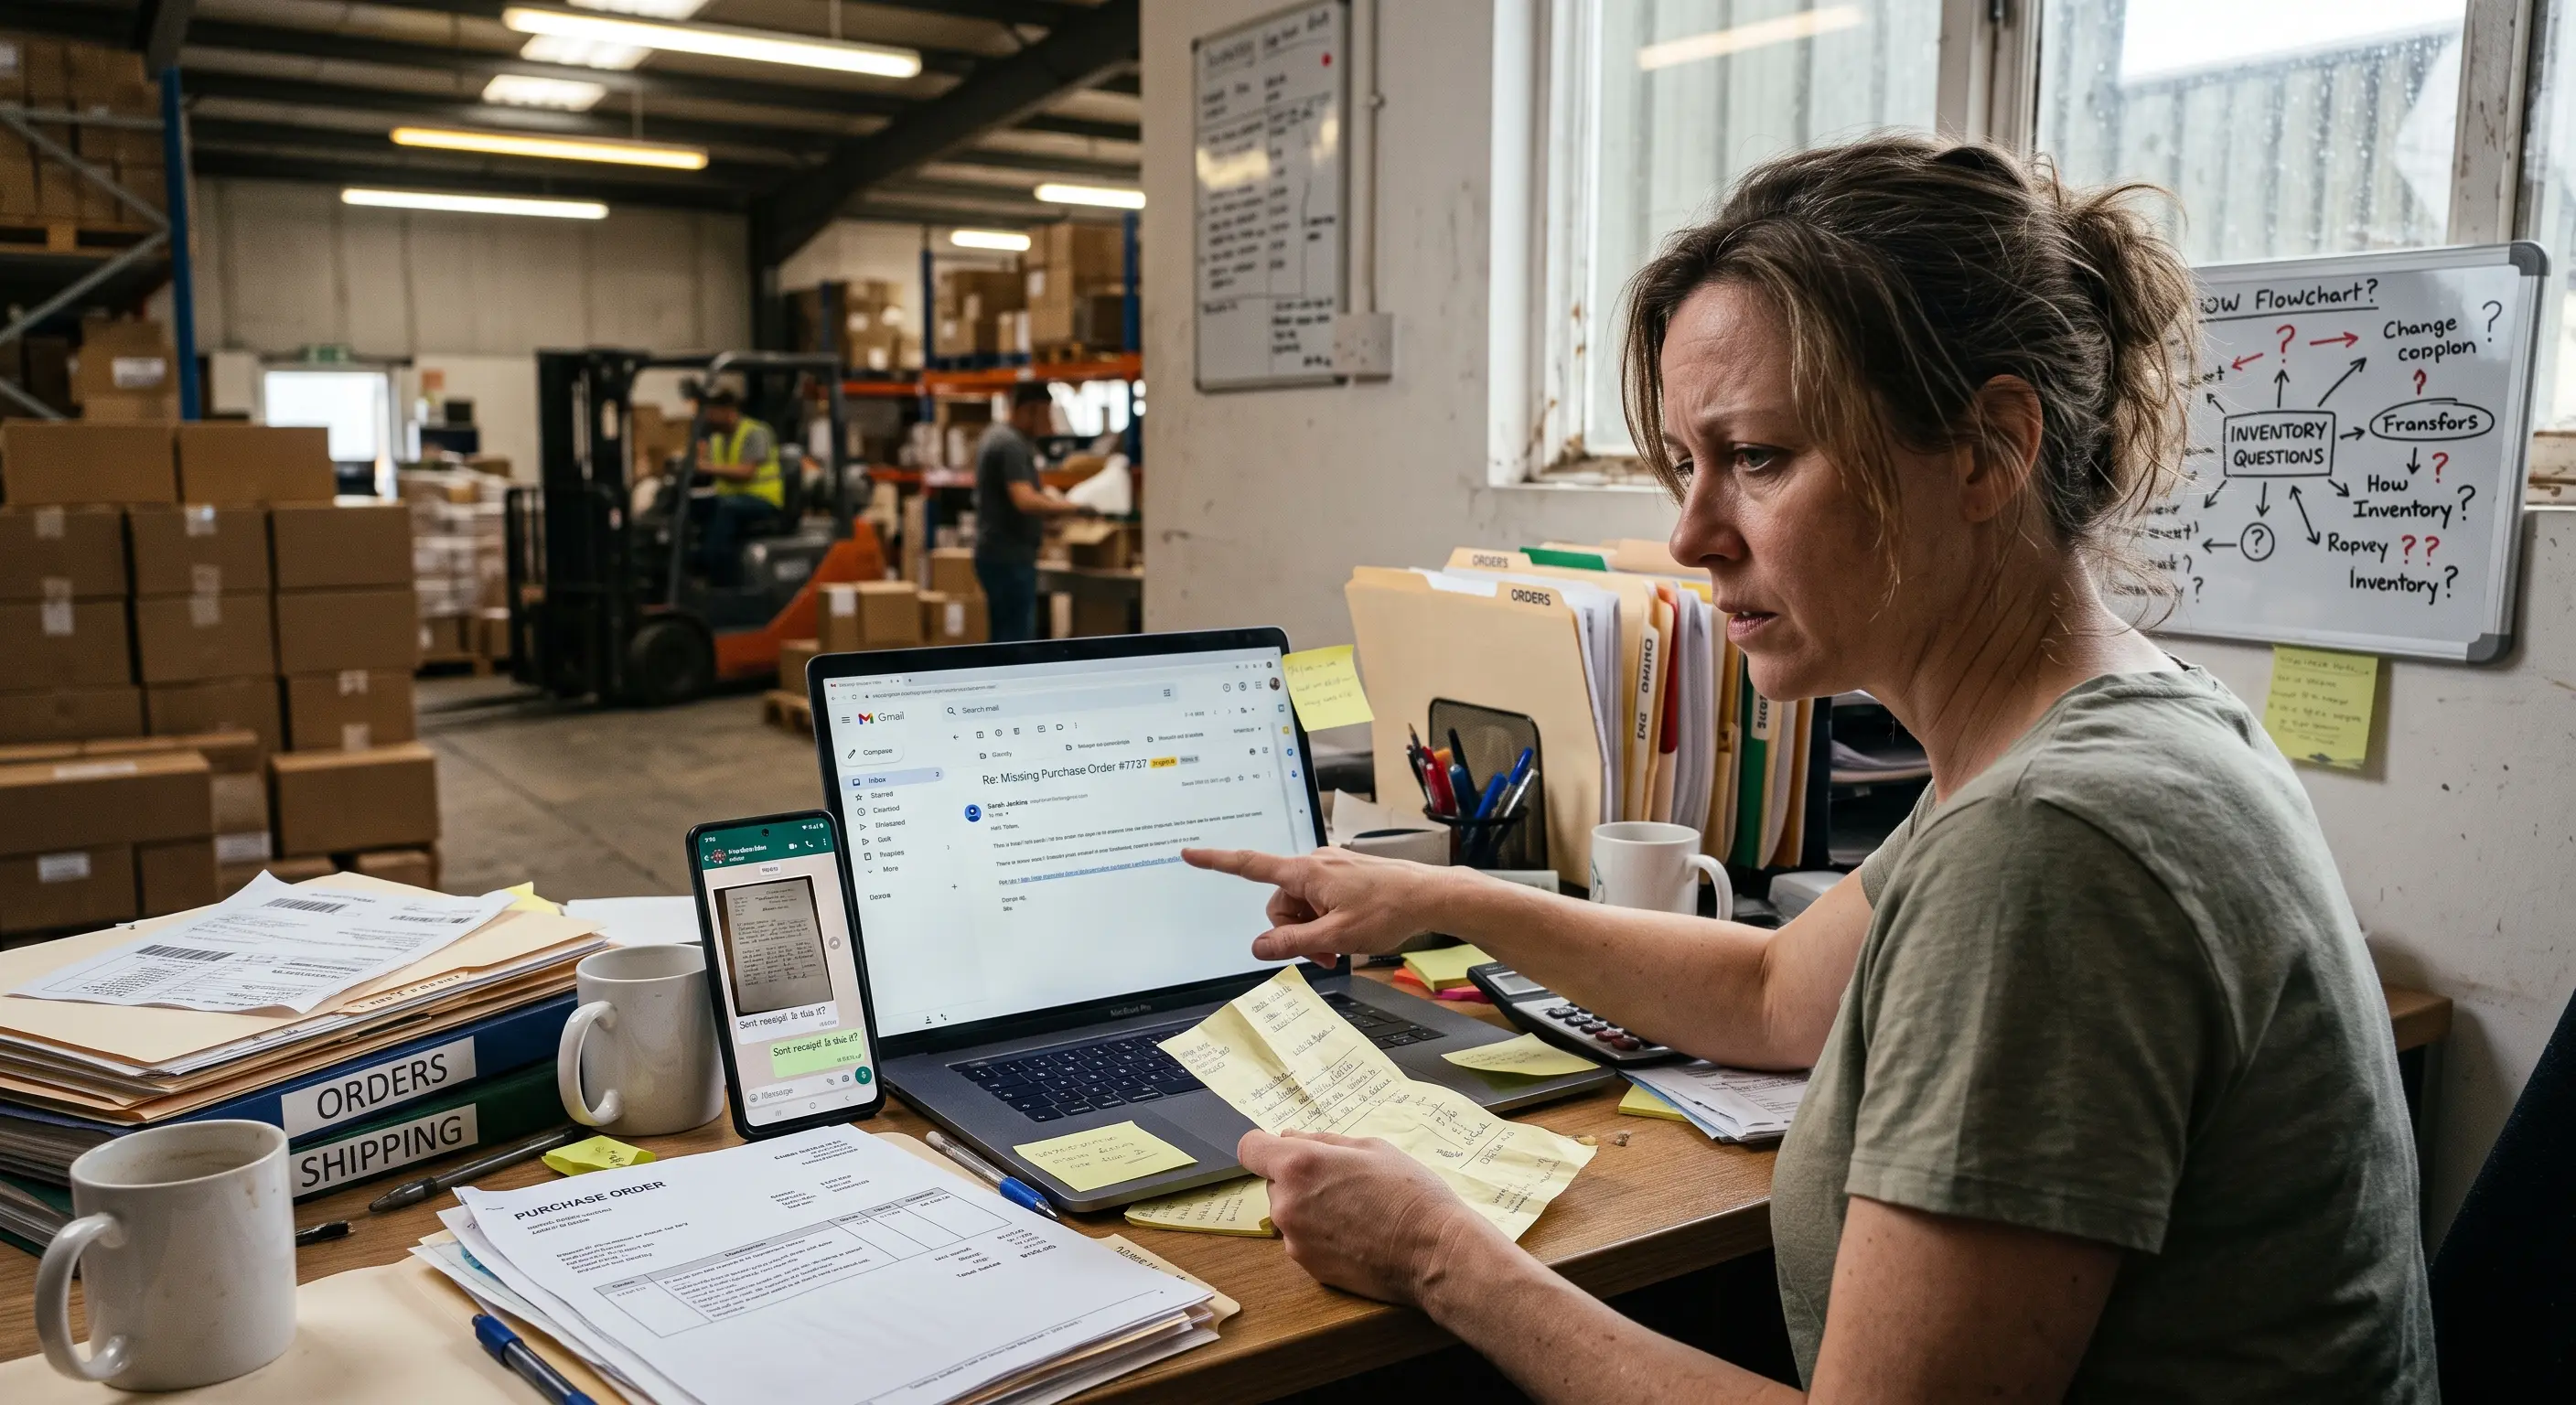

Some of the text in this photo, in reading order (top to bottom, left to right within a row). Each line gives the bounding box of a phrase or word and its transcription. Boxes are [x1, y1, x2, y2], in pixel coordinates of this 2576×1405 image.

[2256, 278, 2378, 309] Flowchart?
[2383, 317, 2458, 339] Change
[2231, 421, 2327, 443] INVENTORY
[2233, 448, 2324, 467] QUESTIONS
[2367, 474, 2409, 492] How
[1511, 588, 1551, 606] ORDERS
[878, 711, 905, 722] Gmail
[982, 775, 999, 785] Re:
[1041, 767, 1086, 778] Purchase
[1088, 763, 1116, 774] Order
[1119, 759, 1147, 770] #7737
[317, 1053, 447, 1120] ORDERS
[301, 1115, 462, 1187] SHIPPING
[513, 1181, 667, 1220] PURCHASE ORDER
